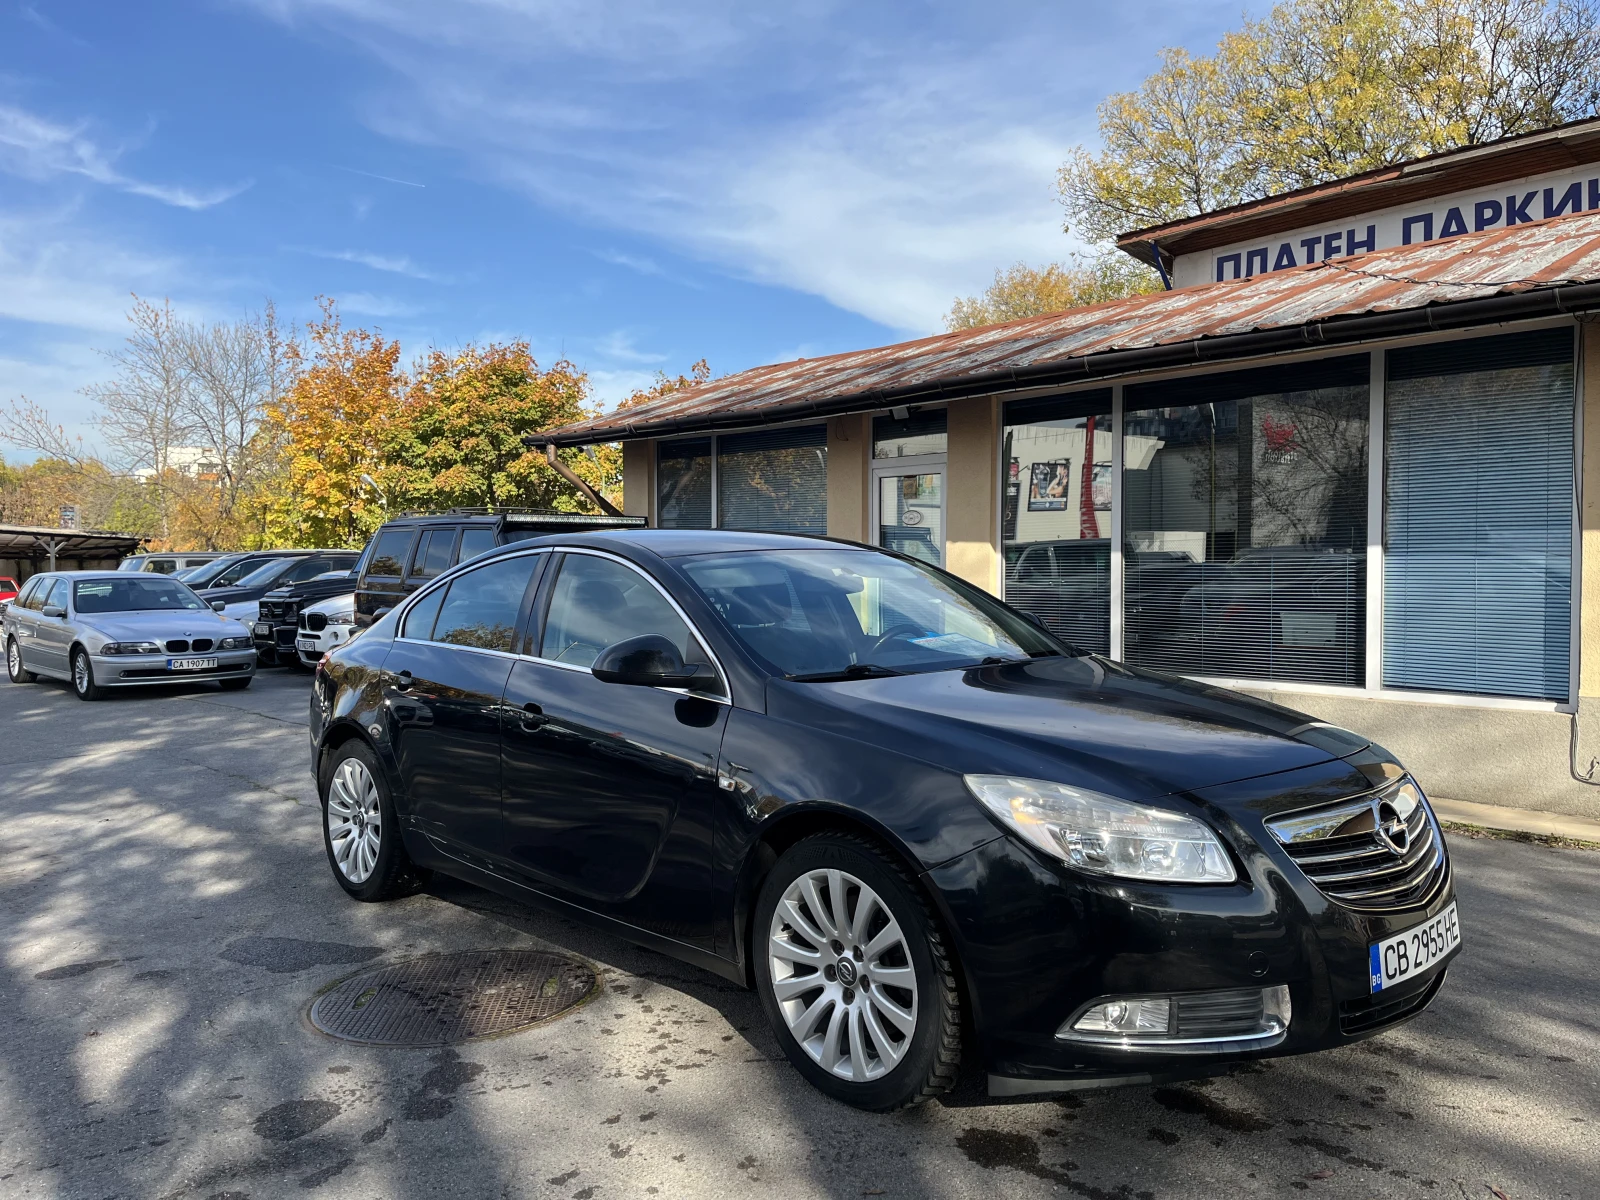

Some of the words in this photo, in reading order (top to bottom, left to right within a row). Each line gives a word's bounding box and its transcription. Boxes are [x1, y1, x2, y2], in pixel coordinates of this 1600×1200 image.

[1216, 224, 1376, 282] ПЛАТЕН
[172, 660, 184, 669] CA
[186, 659, 205, 668] 1907
[206, 658, 217, 667] TT
[1384, 939, 1410, 980] CB
[1411, 918, 1445, 970] 2955
[1443, 907, 1459, 948] HE
[1371, 973, 1381, 987] BG
